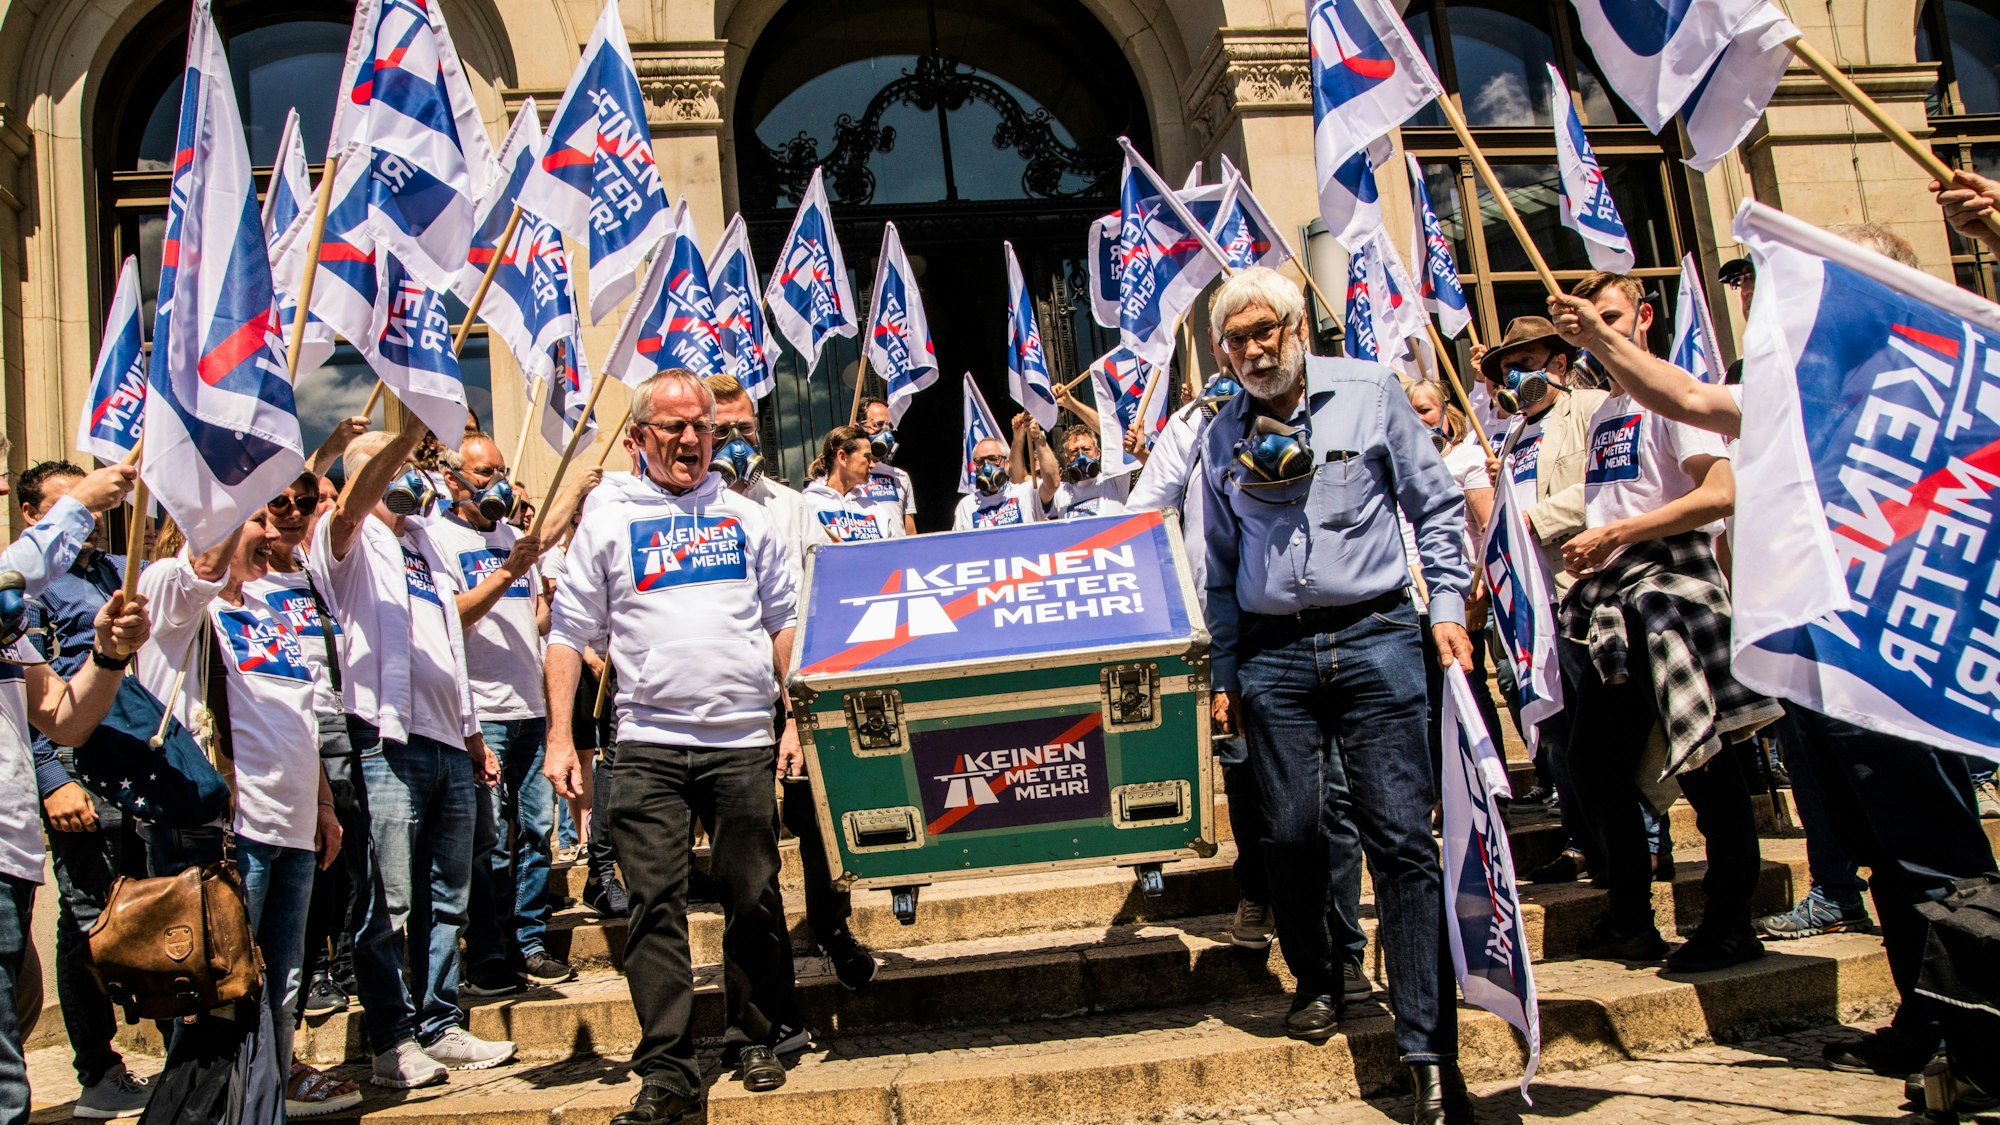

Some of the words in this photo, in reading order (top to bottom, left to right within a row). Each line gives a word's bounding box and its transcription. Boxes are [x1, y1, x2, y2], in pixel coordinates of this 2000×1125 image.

[598, 88, 664, 198] EINEN
[1594, 426, 1635, 448] KEINEN
[1602, 442, 1632, 458] METER
[1604, 454, 1631, 469] MEHR!
[658, 525, 738, 547] KEINEN
[684, 539, 739, 556] METER
[691, 551, 741, 569] MEHR!
[906, 544, 1136, 592] KEINEN
[977, 572, 1140, 606] METER
[994, 592, 1145, 628] MEHR!
[964, 741, 1086, 772] KEINEN
[1004, 763, 1088, 786] METER
[1014, 778, 1090, 801] MEHR!
